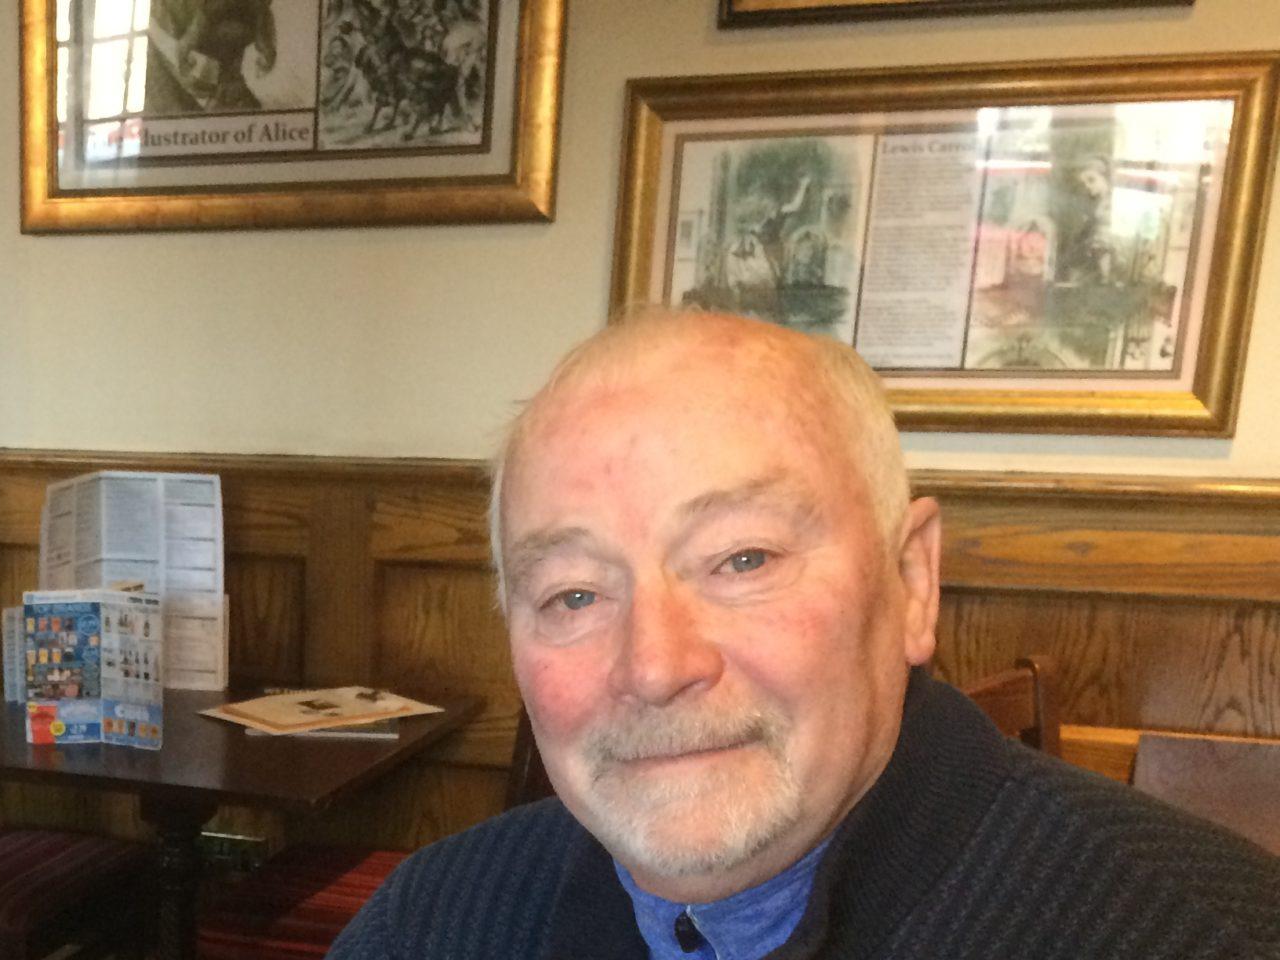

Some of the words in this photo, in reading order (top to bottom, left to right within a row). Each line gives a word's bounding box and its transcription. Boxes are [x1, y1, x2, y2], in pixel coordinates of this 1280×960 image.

[140, 127, 228, 147] lustrator
[234, 124, 256, 143] of
[259, 122, 310, 142] Alice
